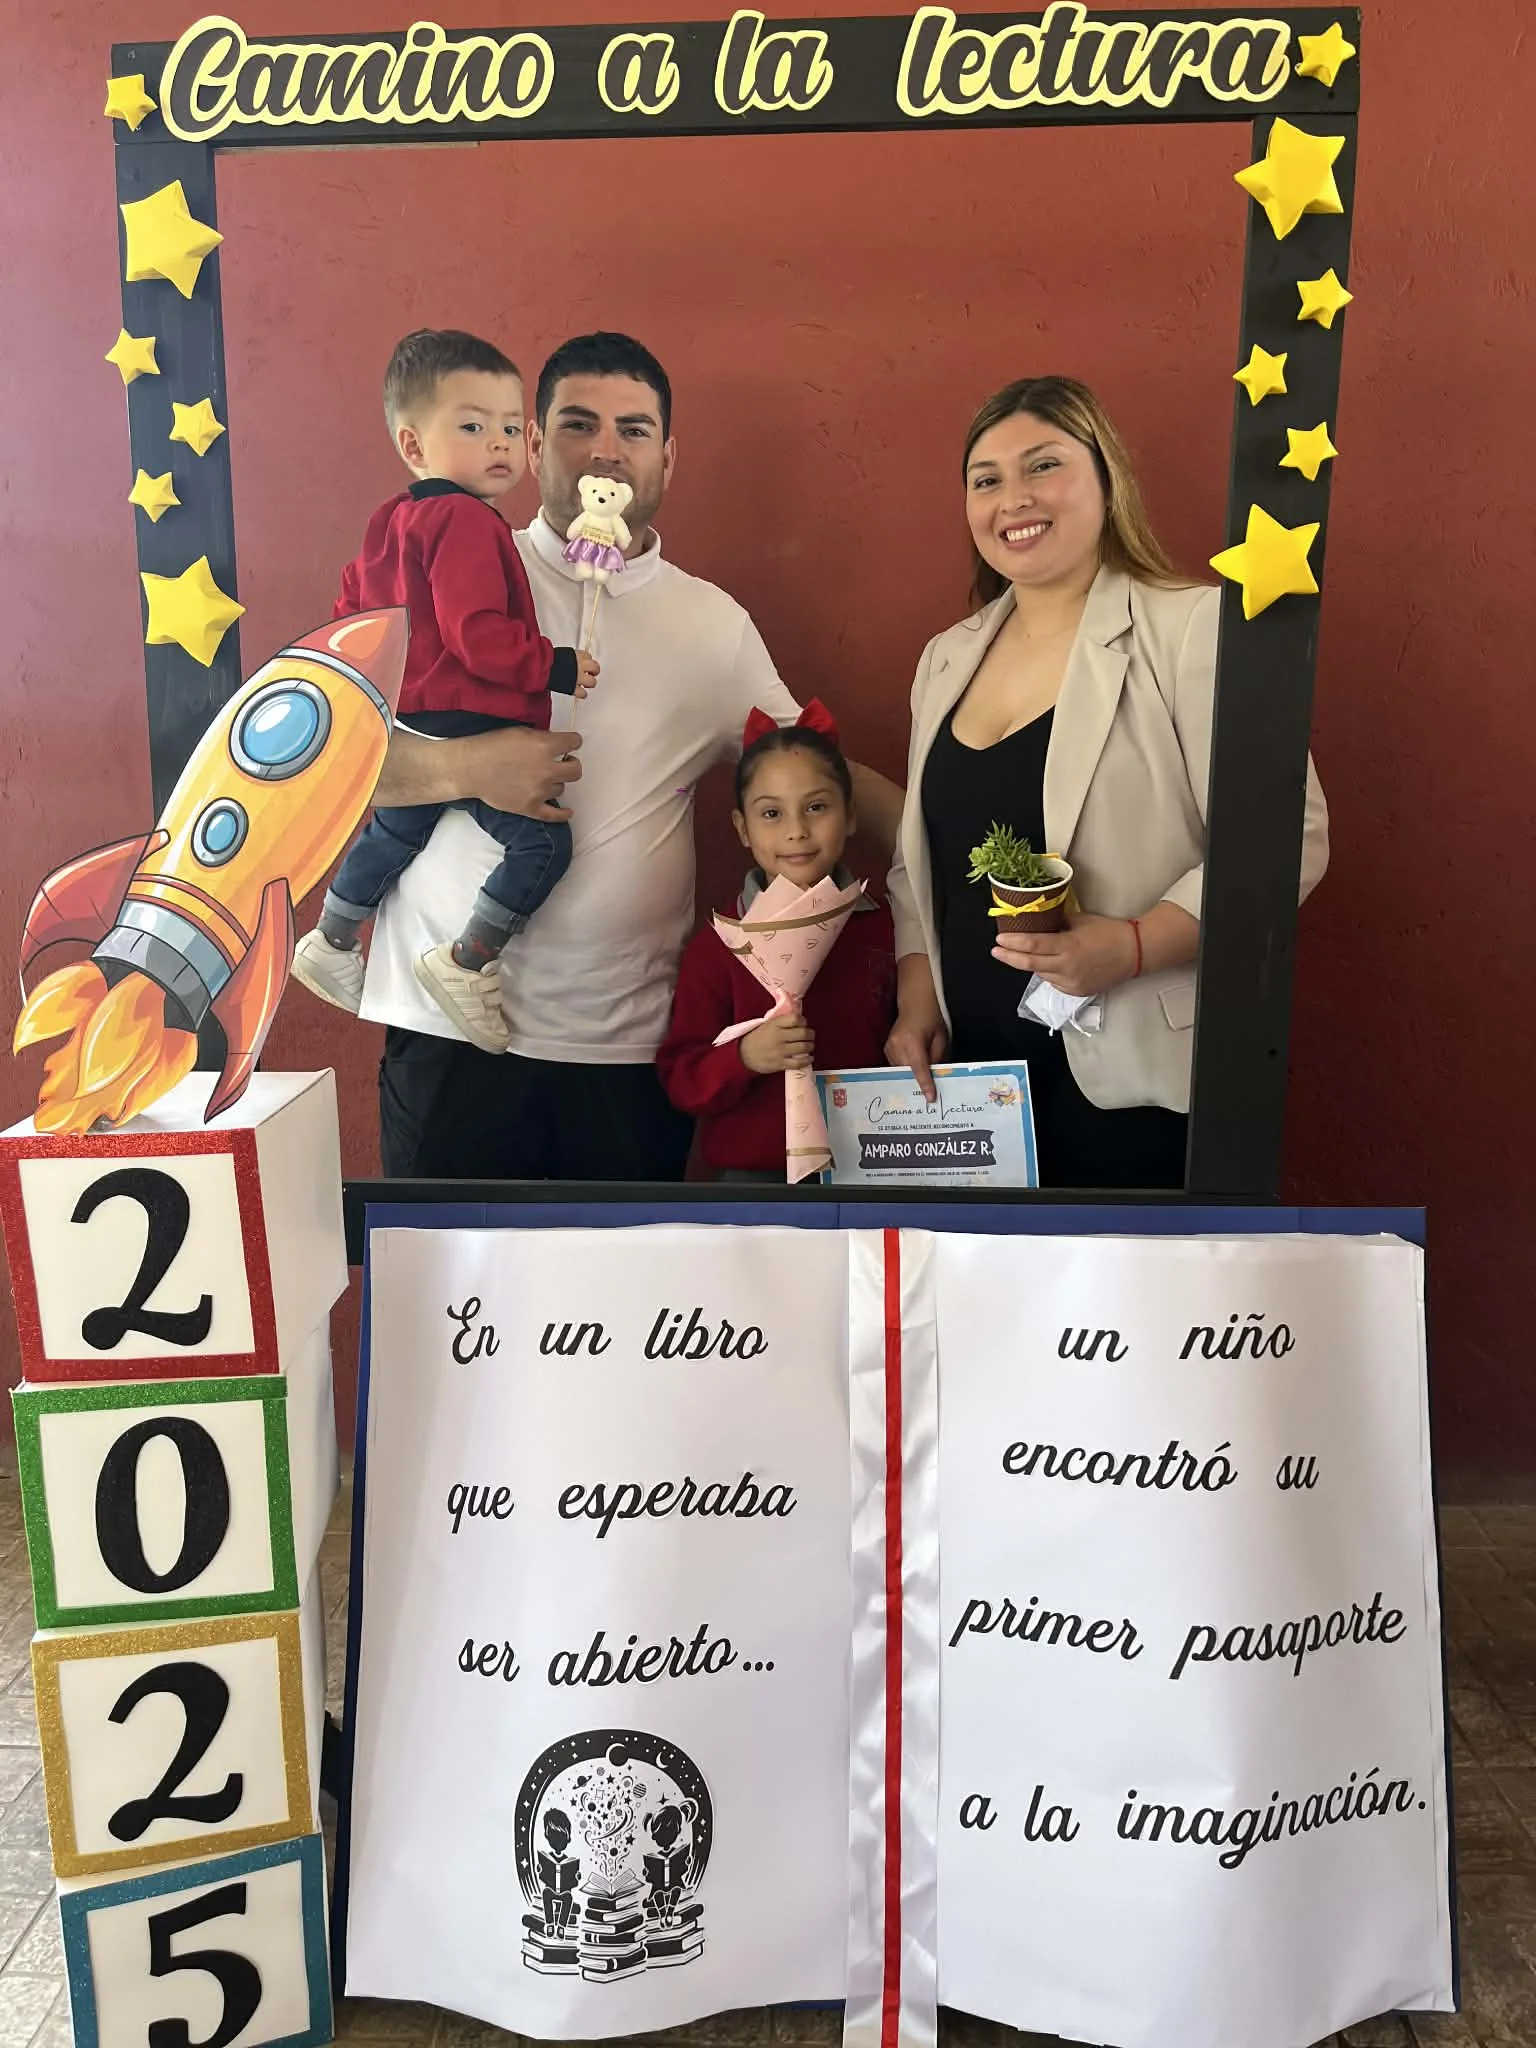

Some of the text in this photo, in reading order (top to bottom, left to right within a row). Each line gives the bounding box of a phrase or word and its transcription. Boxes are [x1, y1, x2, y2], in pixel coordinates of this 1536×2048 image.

[162, 2, 1290, 140] Camino a la lectura
[865, 1143, 911, 1158] AMPARO
[915, 1136, 976, 1156] GONZÁLEZ
[71, 1168, 213, 1350] 2
[446, 1296, 769, 1364] En un libro
[1058, 1313, 1296, 1362] un niño
[447, 1471, 798, 1539] que esperaba
[1002, 1440, 1320, 1492] encontró su
[458, 1638, 520, 1682] ser
[948, 1591, 1407, 1680] primer pasaporte
[107, 1661, 243, 1842] 2
[959, 1766, 1426, 1870] a la imaginación.
[148, 1881, 263, 2048] 5
